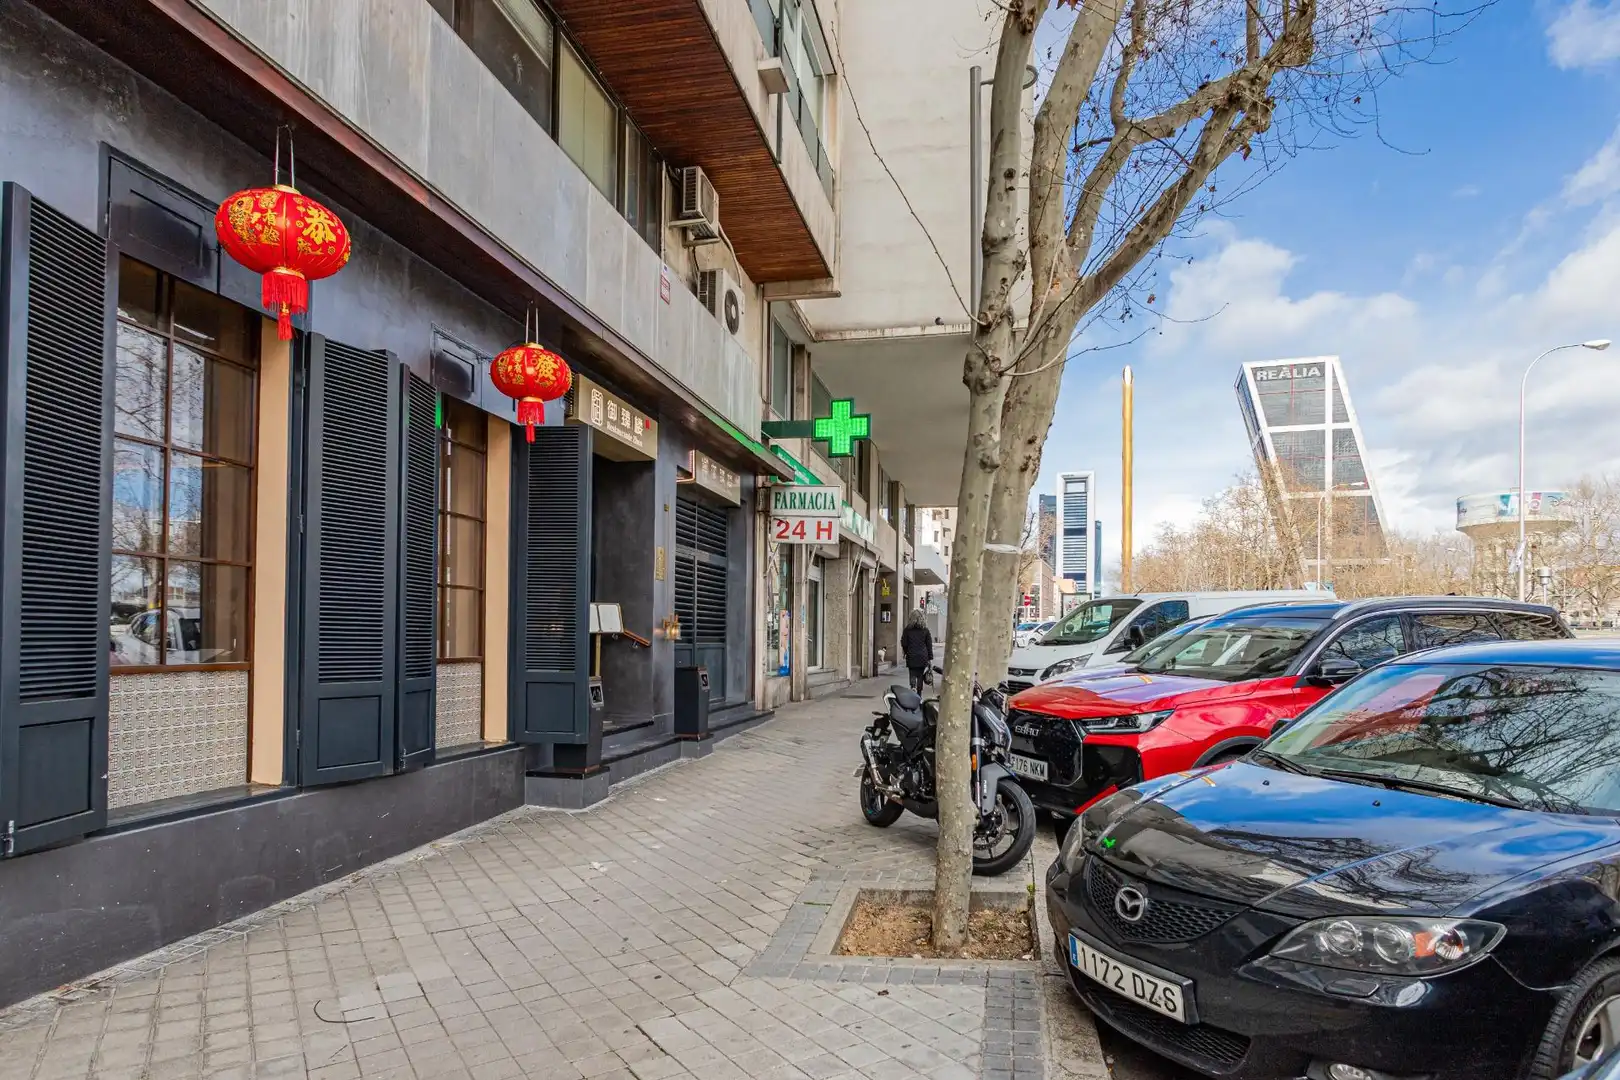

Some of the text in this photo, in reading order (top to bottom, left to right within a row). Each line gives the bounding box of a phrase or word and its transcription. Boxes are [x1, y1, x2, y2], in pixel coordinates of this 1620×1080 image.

[1256, 367, 1321, 381] REALIA
[774, 492, 836, 510] FARMACIA
[776, 520, 807, 540] 24
[816, 520, 833, 540] H
[1081, 947, 1177, 1013] 1172 DZS
